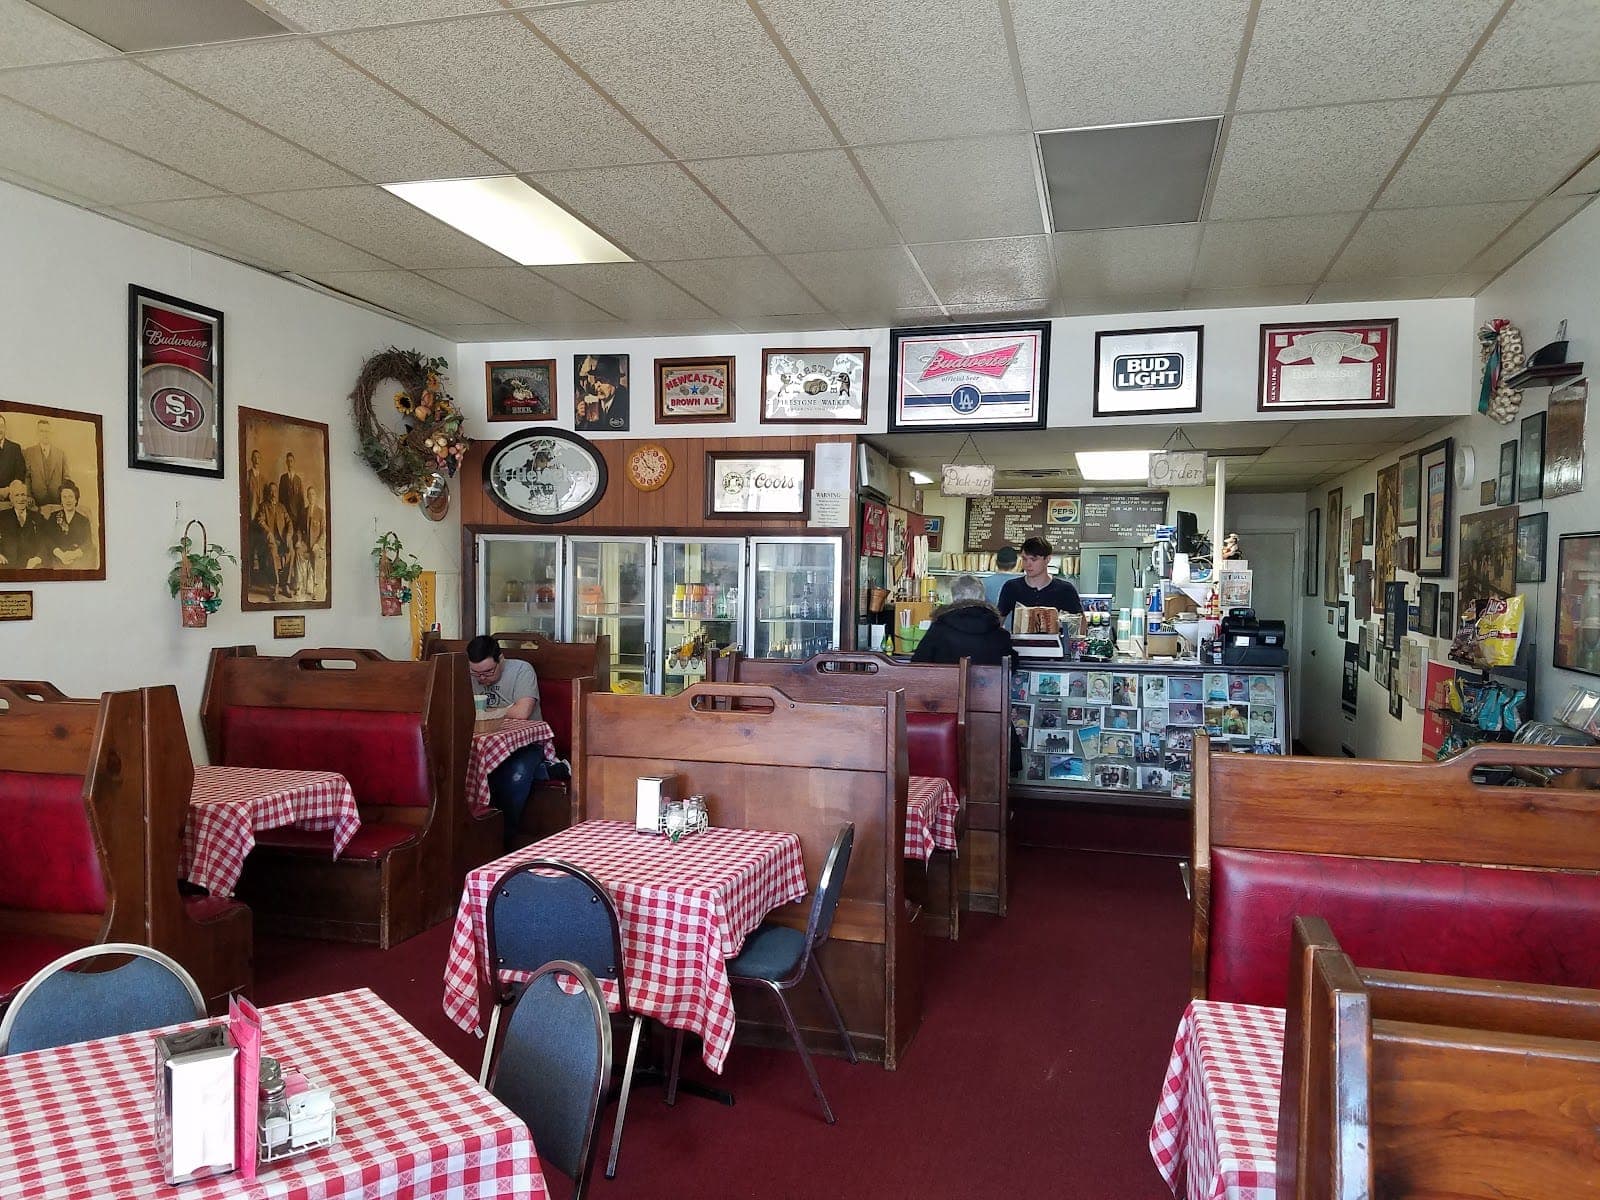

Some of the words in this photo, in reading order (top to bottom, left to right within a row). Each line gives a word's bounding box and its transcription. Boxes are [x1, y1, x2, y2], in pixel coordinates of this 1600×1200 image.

[146, 330, 208, 349] Budweiser
[918, 354, 1019, 371] Budweiser
[1127, 357, 1170, 372] BUD
[665, 373, 725, 391] NEWCASTLE
[1118, 370, 1178, 387] LIGHT
[670, 398, 701, 407] BROWN
[704, 397, 720, 405] ALE
[958, 389, 974, 409] LA
[165, 393, 195, 427] SF
[1153, 459, 1203, 481] Order
[754, 472, 795, 490] Coors
[945, 468, 991, 492] Pick-up
